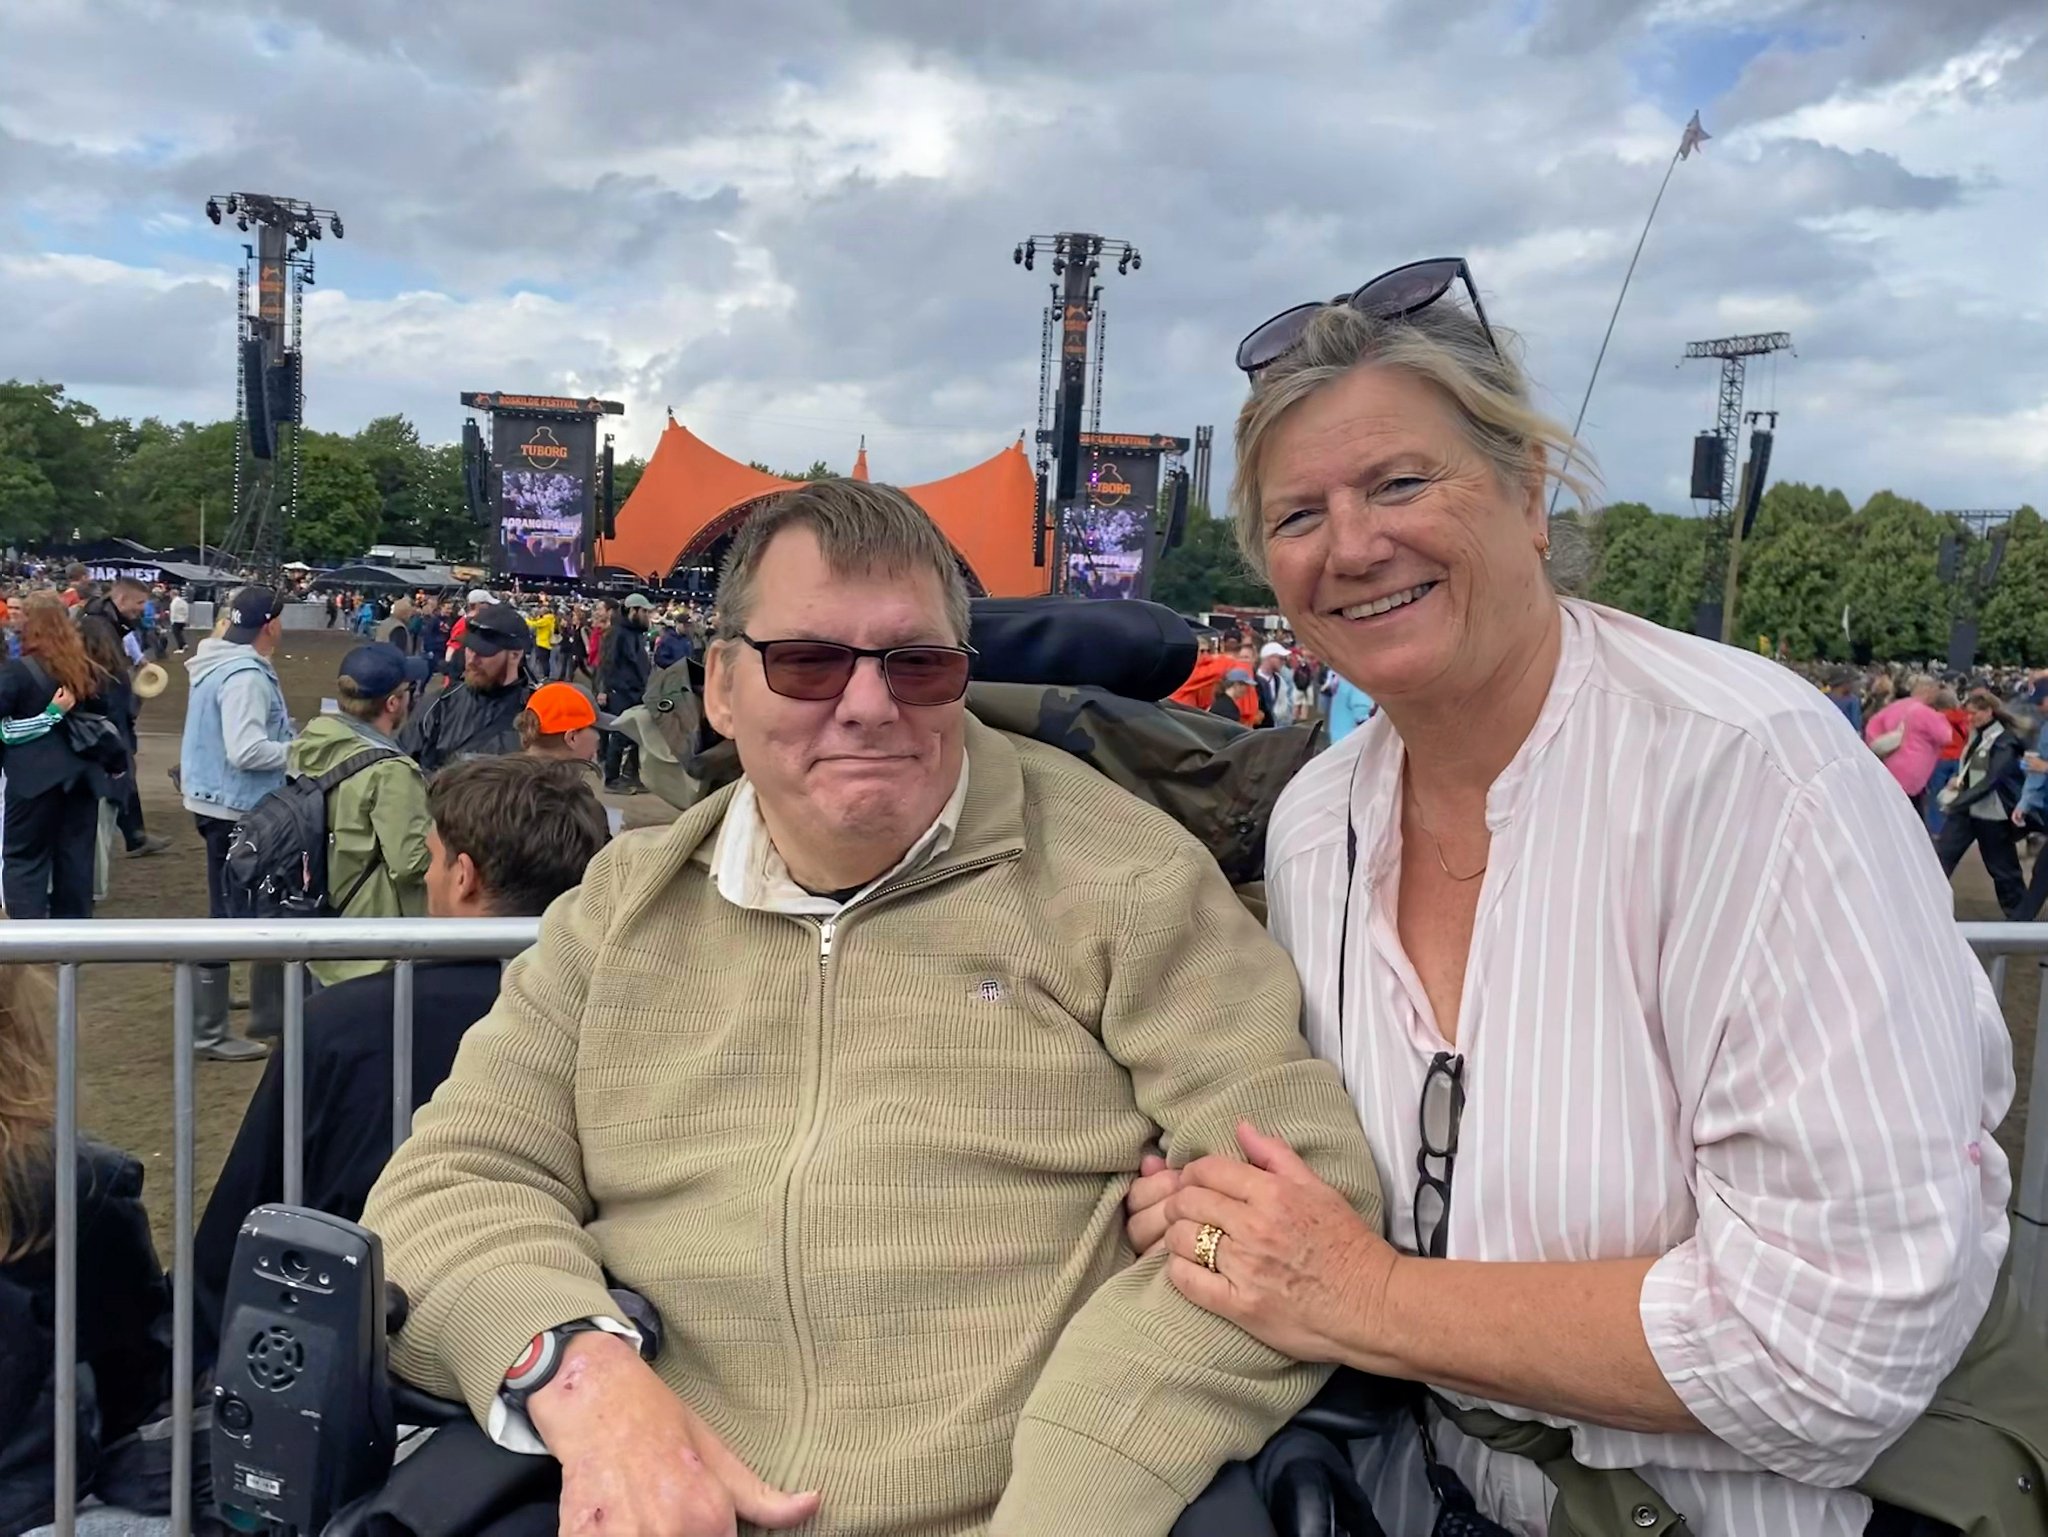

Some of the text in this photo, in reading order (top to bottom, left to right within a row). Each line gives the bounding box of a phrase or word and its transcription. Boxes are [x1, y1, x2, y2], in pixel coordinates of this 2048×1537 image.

[541, 398, 579, 409] FESTIVAL
[520, 444, 568, 458] TUBORG
[120, 567, 162, 582] WEST
